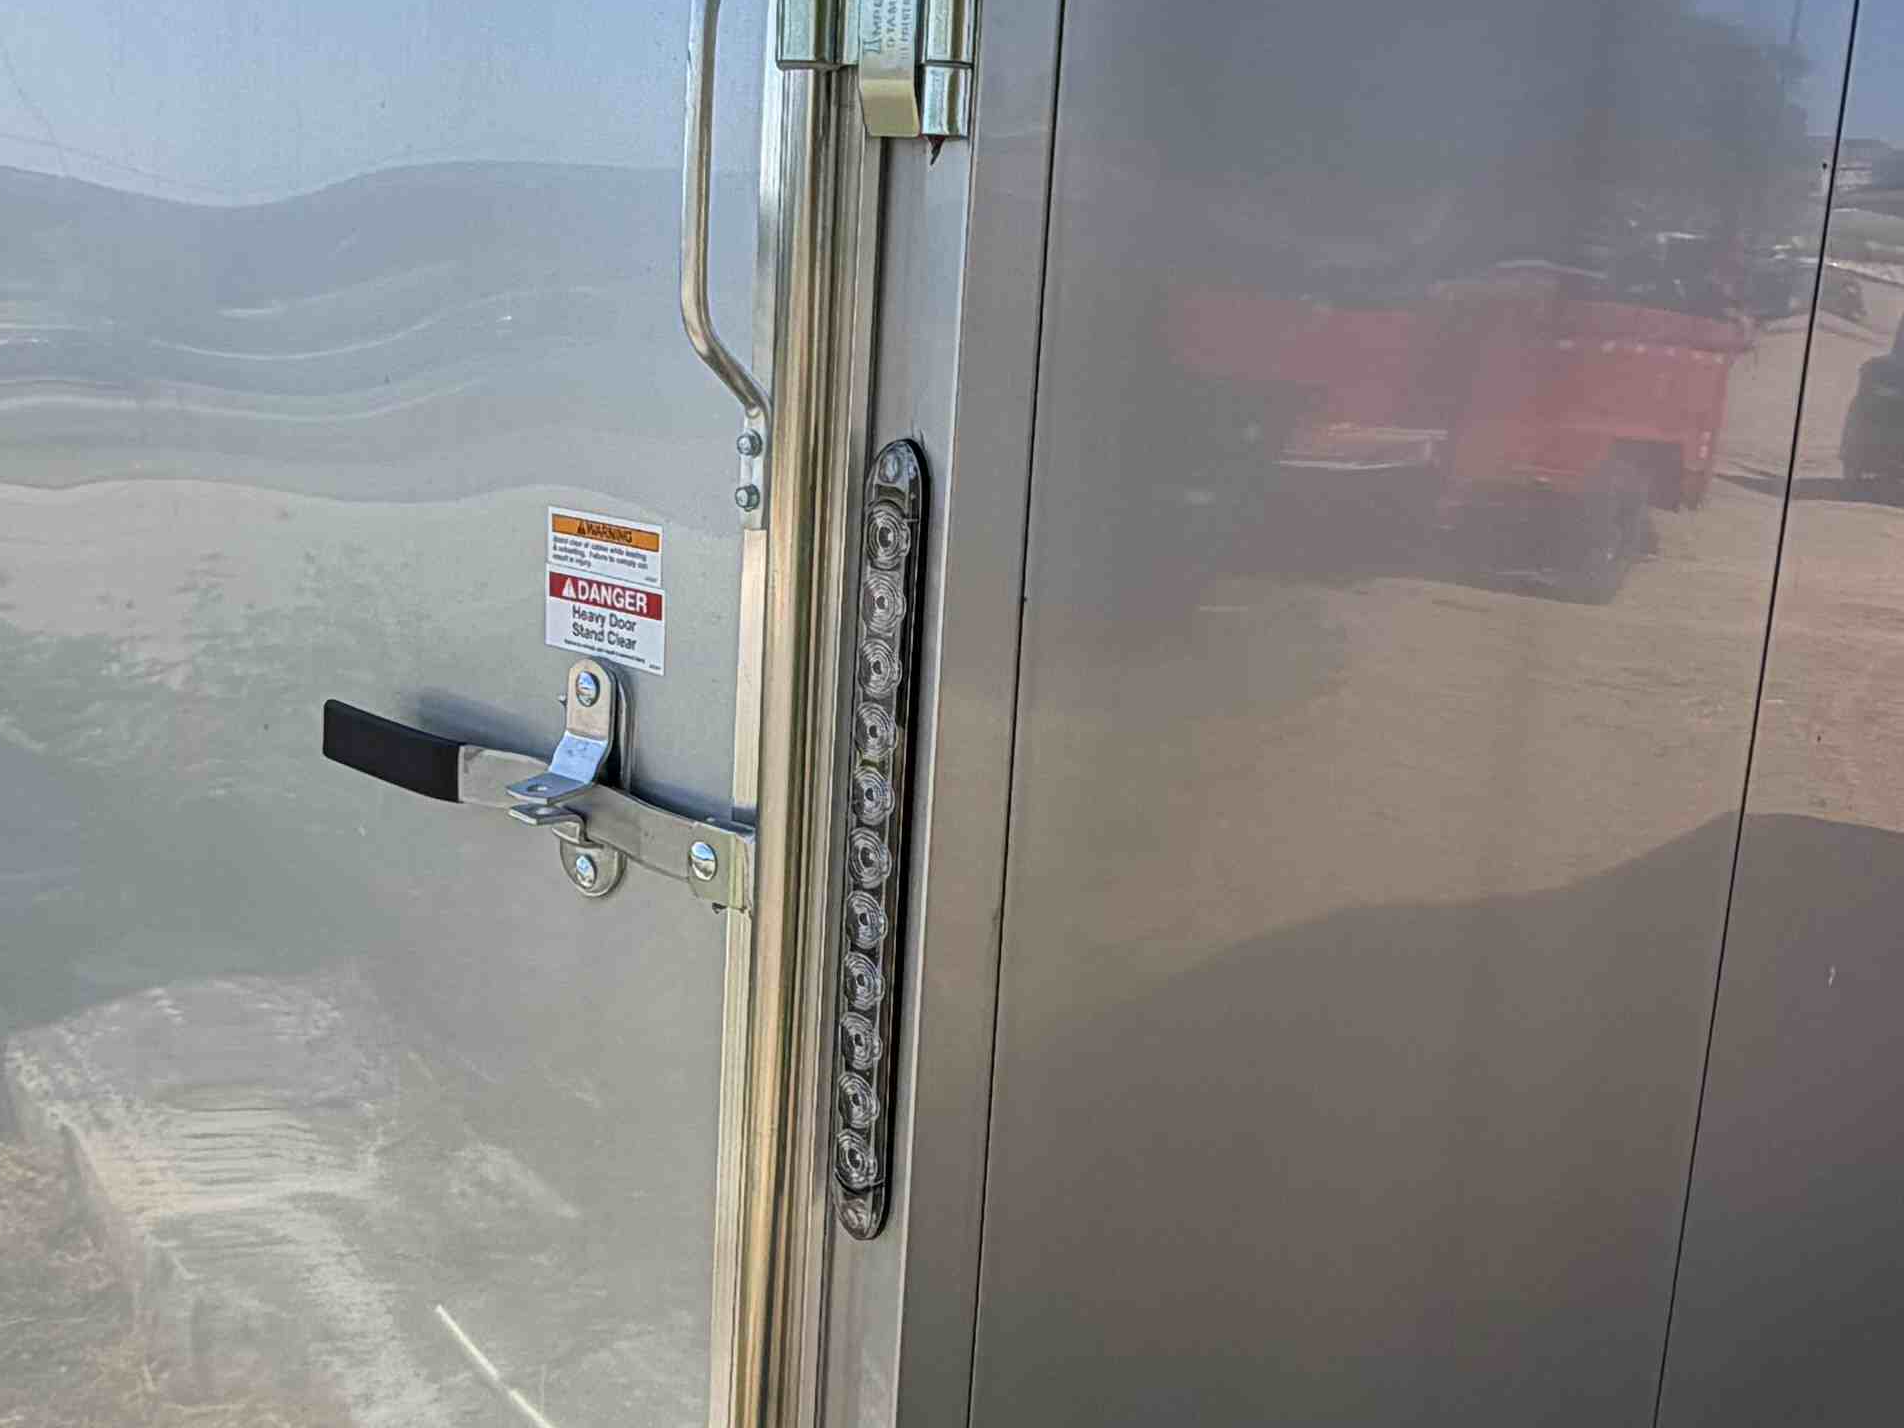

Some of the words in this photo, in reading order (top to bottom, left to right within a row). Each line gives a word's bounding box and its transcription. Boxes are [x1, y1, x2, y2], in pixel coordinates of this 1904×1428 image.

[587, 521, 633, 544] WARNING
[577, 579, 647, 614] DANGER
[572, 604, 606, 628] Heavy
[609, 612, 637, 632] Door
[572, 622, 605, 643] Stand
[608, 630, 637, 651] Clear
